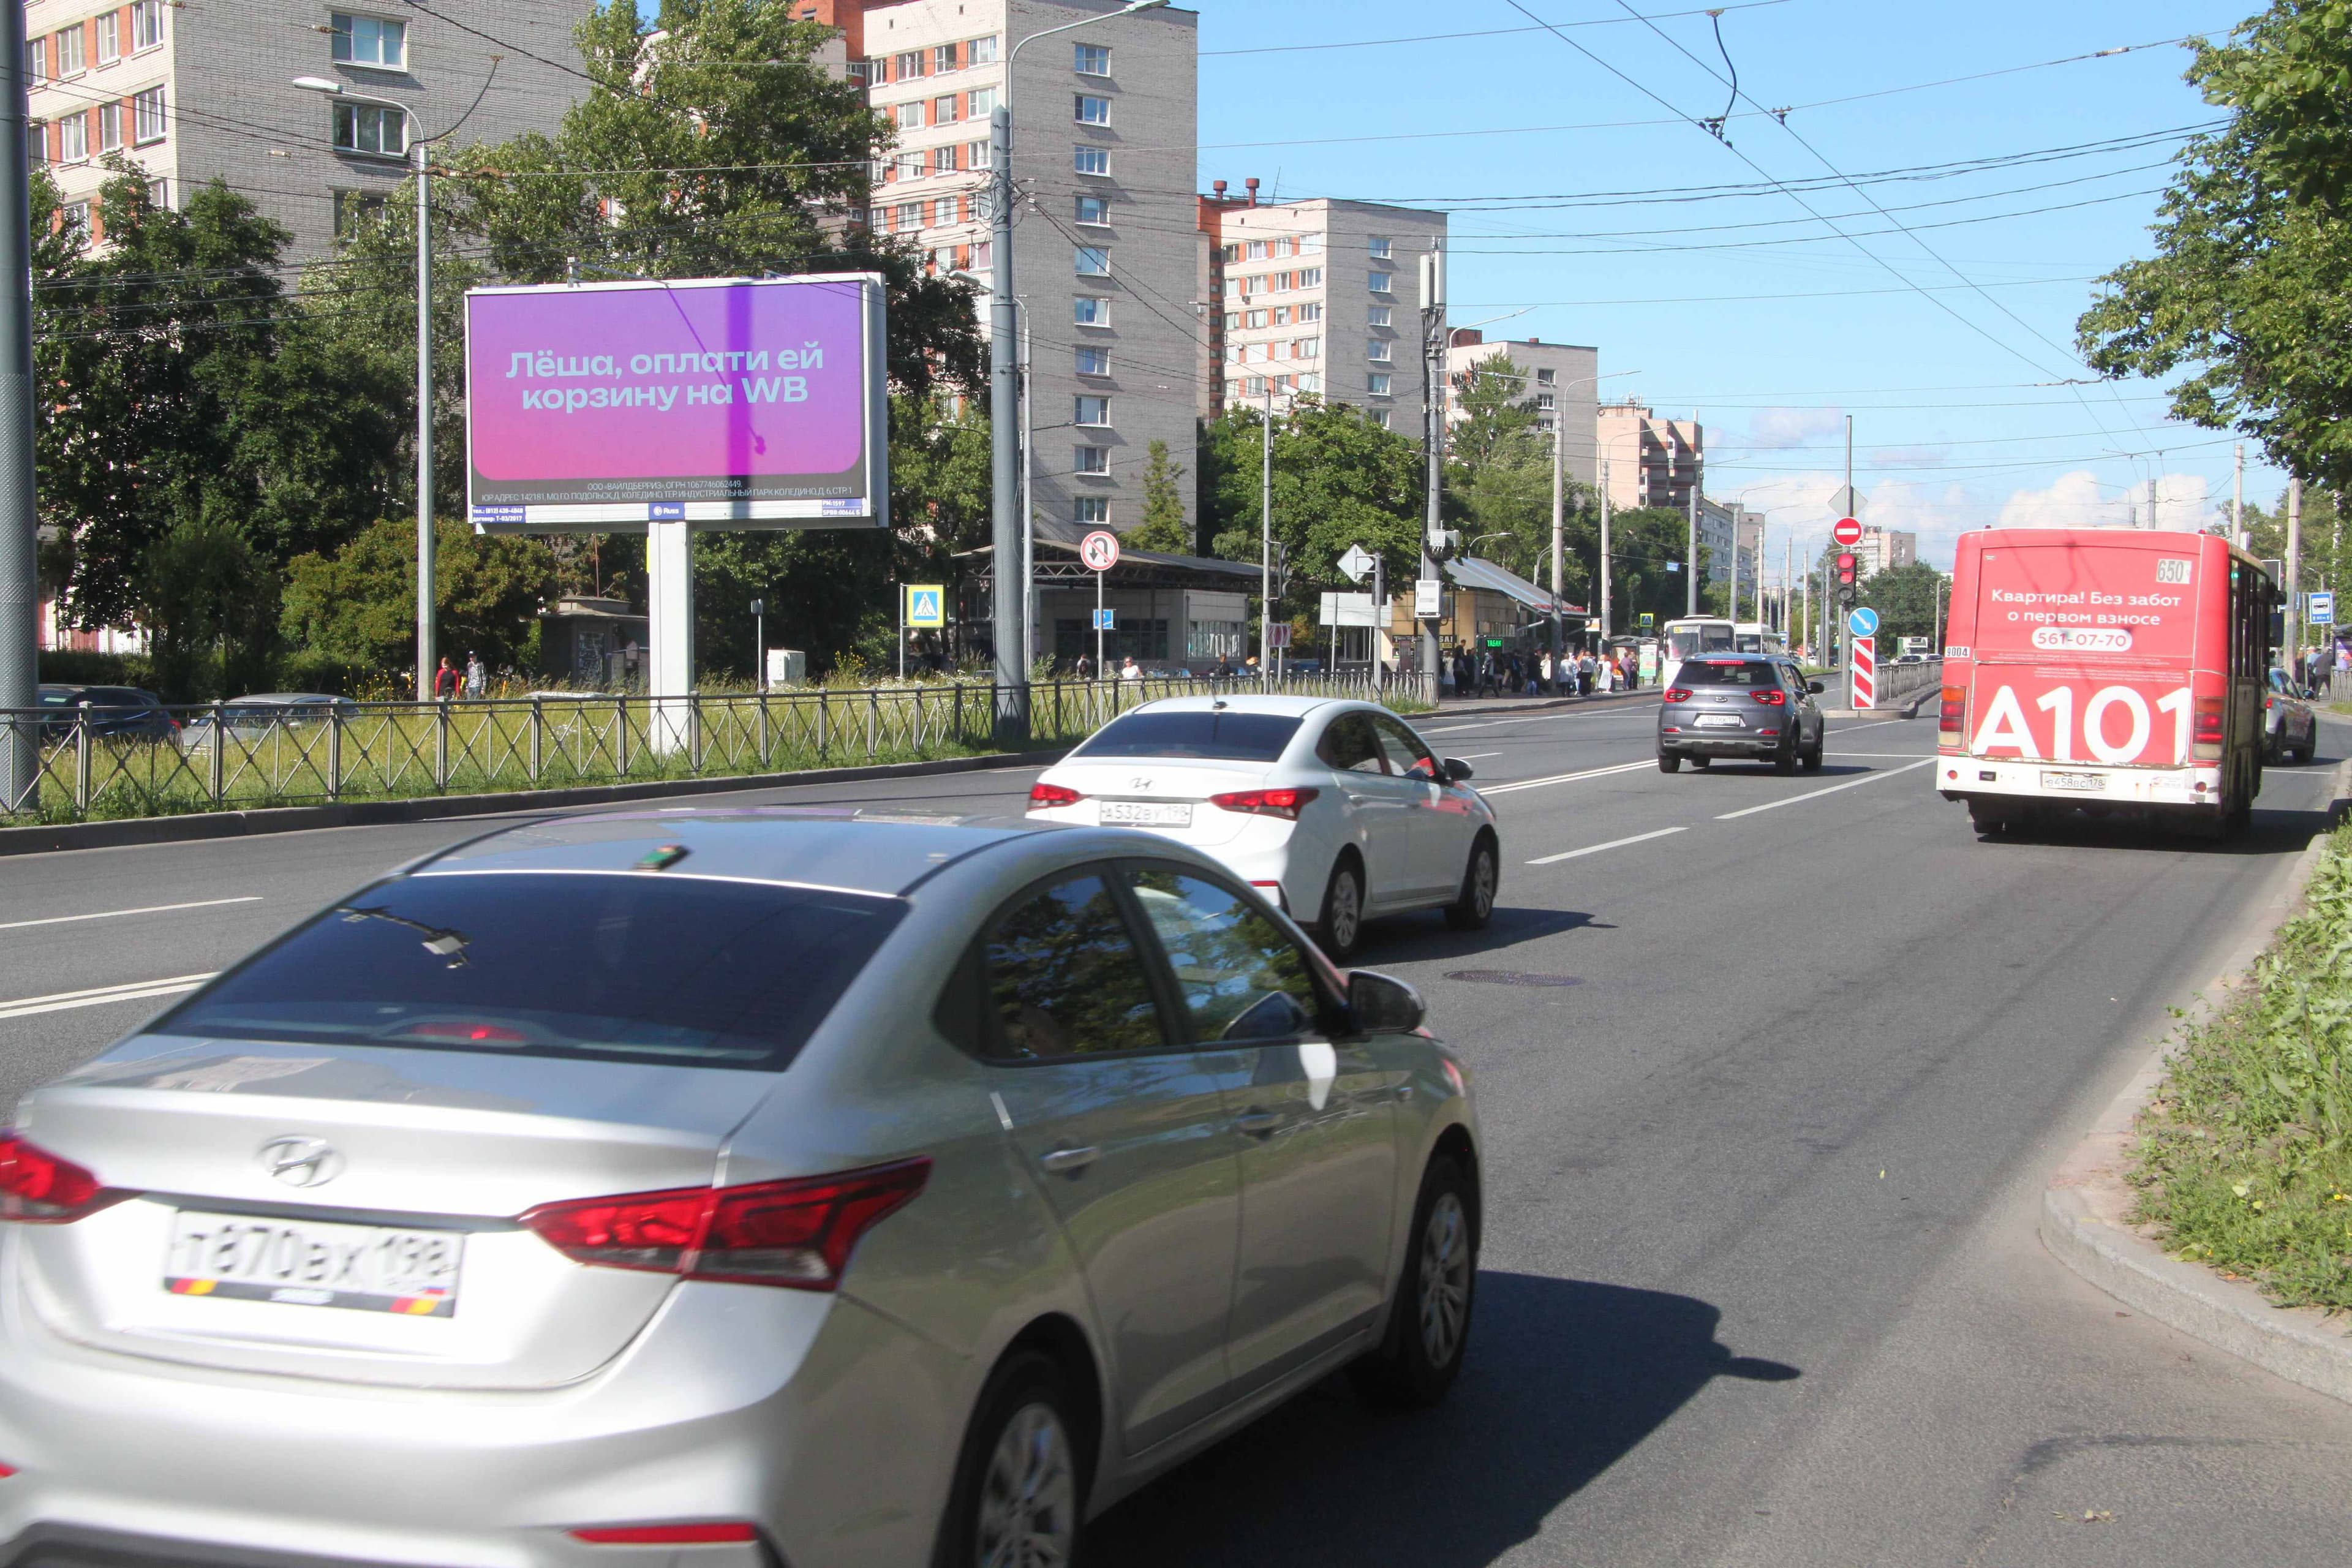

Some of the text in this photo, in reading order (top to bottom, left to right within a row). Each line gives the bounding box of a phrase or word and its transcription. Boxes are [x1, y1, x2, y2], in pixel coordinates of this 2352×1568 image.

[505, 341, 823, 379] Лёша, оплати ей
[522, 376, 809, 413] корзину на WB
[2157, 560, 2184, 582] 650
[1991, 589, 2181, 606] Квартира! Без забот
[2007, 611, 2161, 625] о первом взносе
[2037, 632, 2127, 647] 561-07-70
[1947, 647, 1969, 657] 9004
